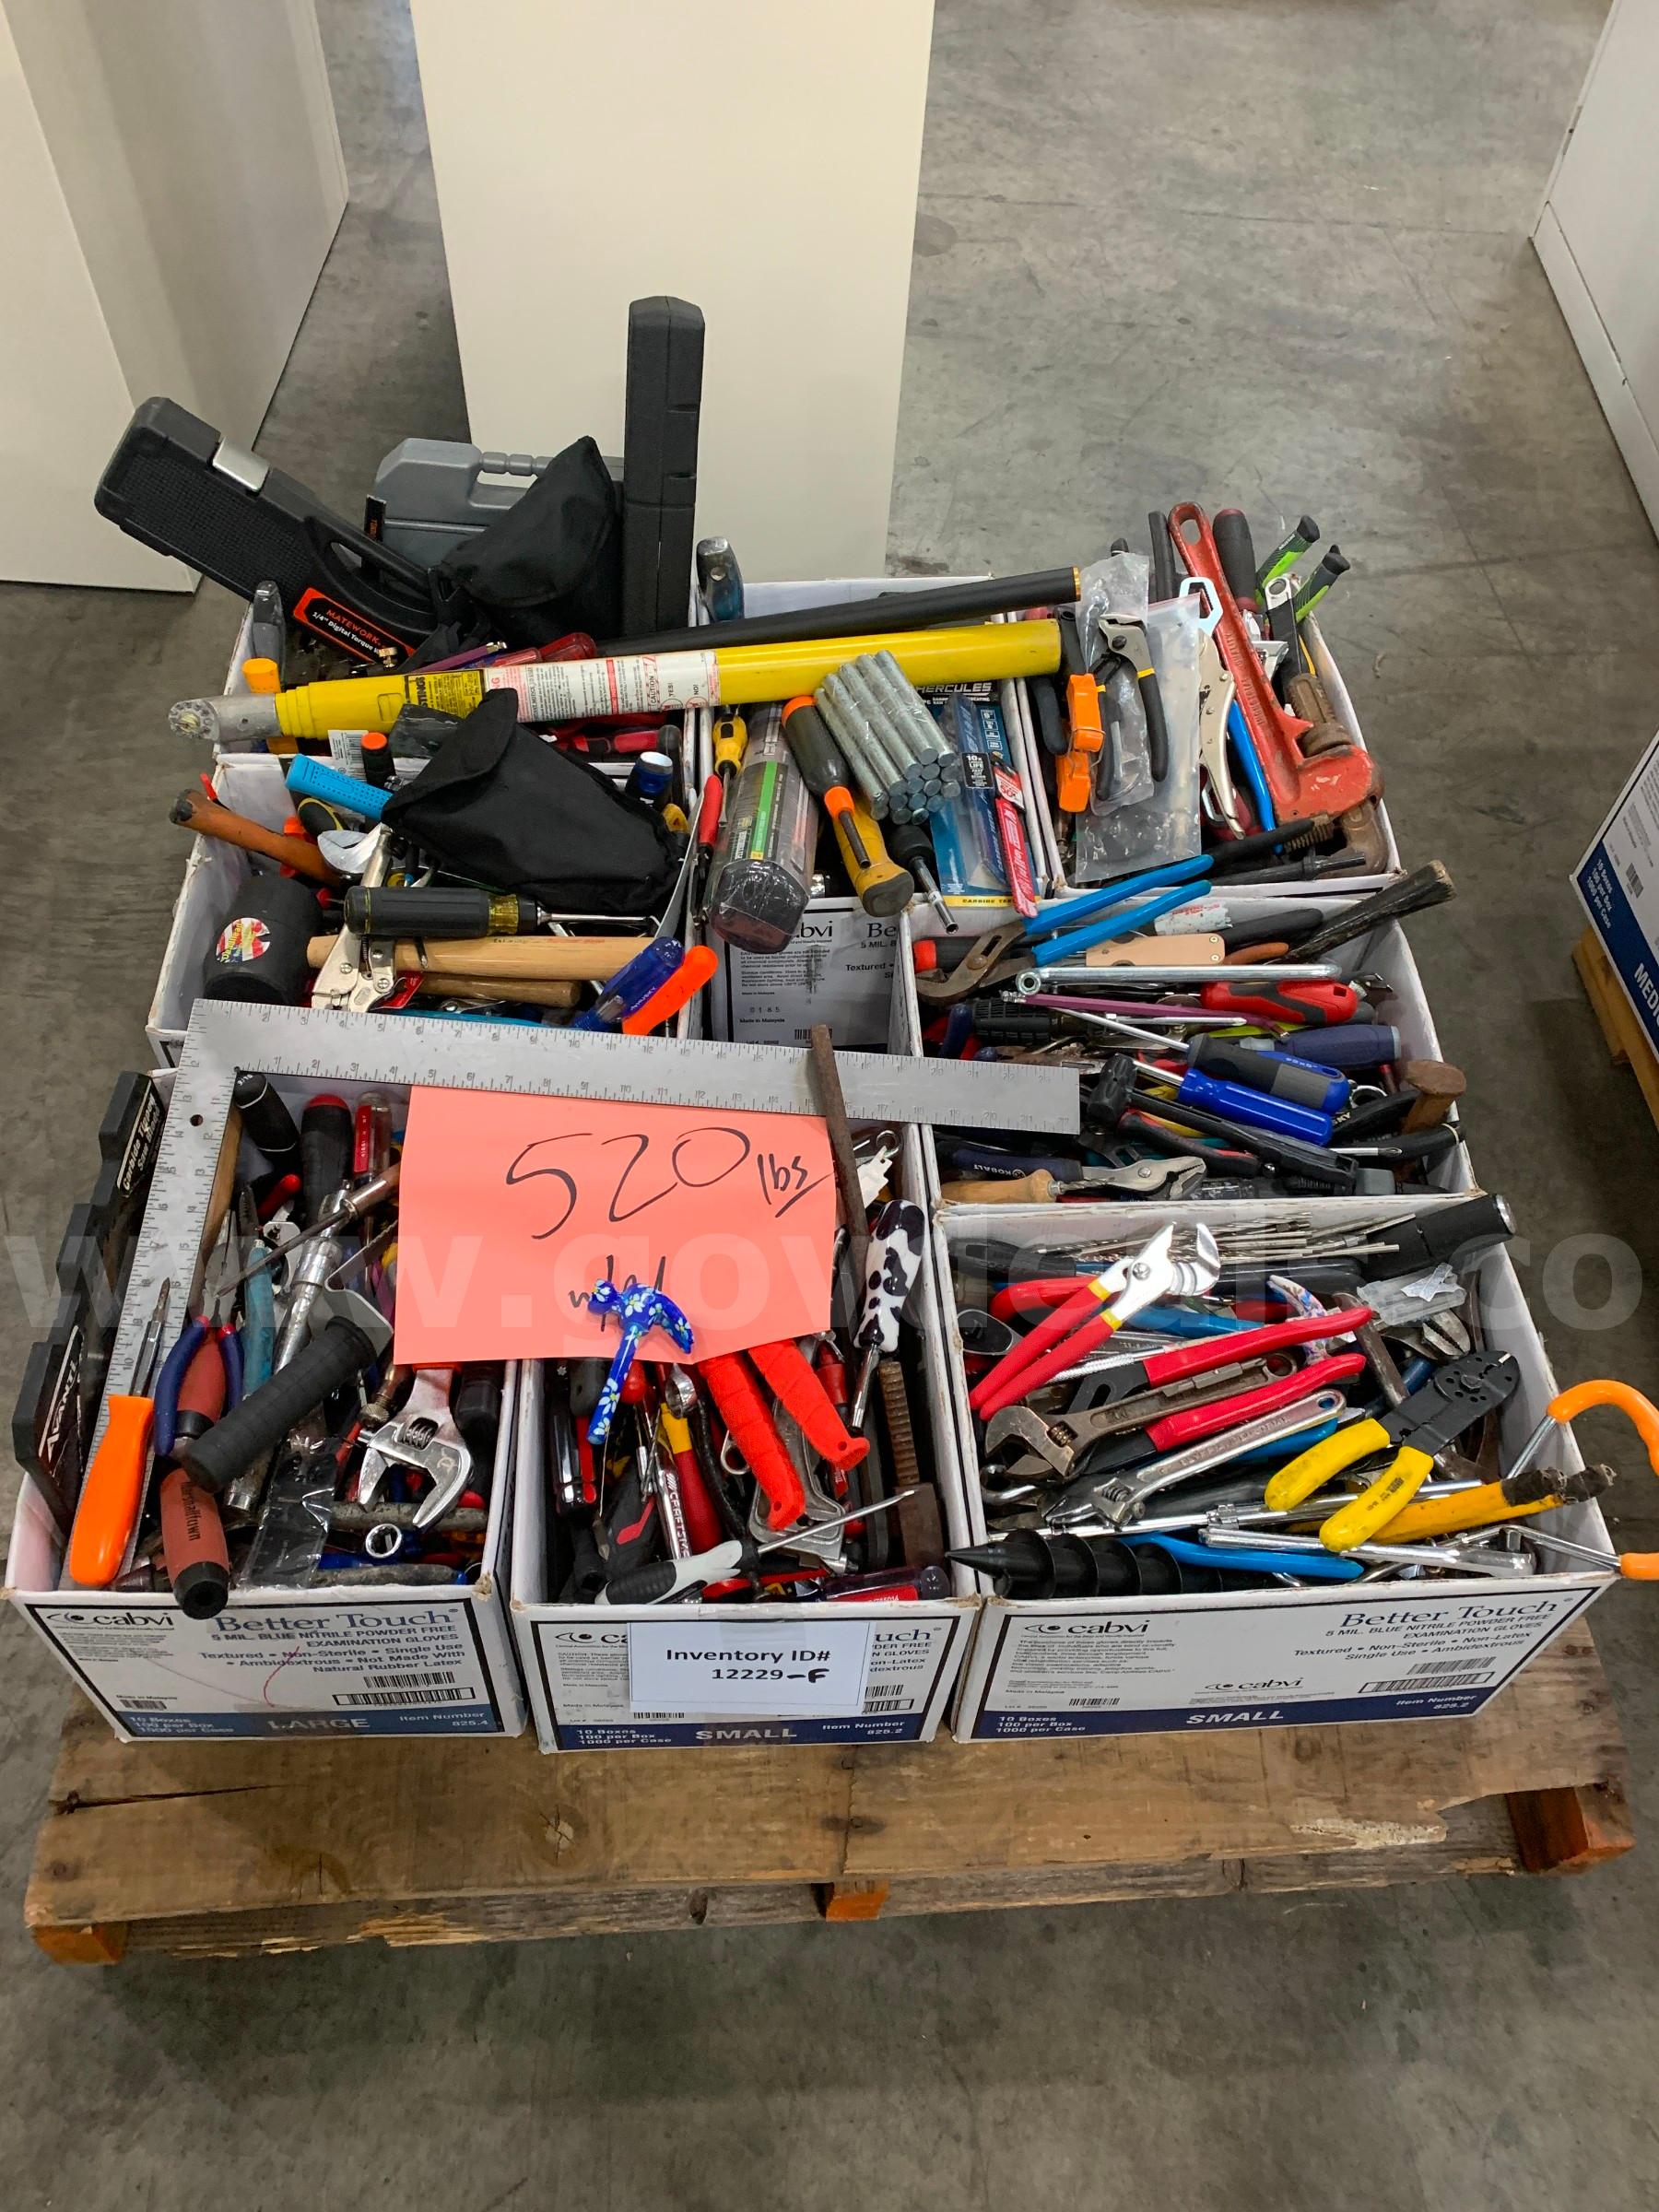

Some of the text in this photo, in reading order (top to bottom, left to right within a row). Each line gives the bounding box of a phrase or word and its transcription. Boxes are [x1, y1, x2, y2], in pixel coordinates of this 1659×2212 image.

[327, 620, 351, 638] Digital
[351, 634, 373, 651] Torque
[915, 683, 993, 693] HERCULES
[796, 921, 833, 938] bvi
[846, 963, 887, 971] Textured
[1634, 962, 1659, 1028] MEDI
[123, 1138, 141, 1191] Carbide
[138, 1146, 148, 1171] Saw
[973, 1164, 1012, 1176] KOBALT
[505, 1126, 836, 1239] 520 lbs
[669, 1493, 691, 1559] CRAFTSMA
[93, 1612, 174, 1626] cabvi
[211, 1610, 454, 1631] Better Touch
[1340, 1600, 1558, 1628] Better Touch
[1067, 1619, 1151, 1634] cabvi
[1369, 1626, 1403, 1634] BLUE
[1406, 1621, 1455, 1631] NITRILE
[1458, 1618, 1515, 1628] POWDER
[1517, 1614, 1550, 1622] FREE
[1403, 1622, 1543, 1639] EXAMINATION GLOVES
[257, 1632, 296, 1641] BLUE
[299, 1630, 352, 1640] NITRILE
[356, 1629, 416, 1637] POWDER
[421, 1626, 456, 1634] FREE
[307, 1634, 459, 1647] EXAMINATION GLOVES
[876, 1630, 931, 1642] uch
[1294, 1631, 1532, 1656] Textured Non-Sterile Non-Latex
[1345, 1652, 1387, 1661] Single
[1433, 1640, 1525, 1653] Ambidextrous
[240, 1658, 341, 1666] Ambidextrous
[389, 1653, 429, 1662] Made
[432, 1650, 465, 1658] With
[281, 1649, 366, 1658] Non-Sterile
[385, 1646, 431, 1654] Single
[666, 1649, 831, 1664] Inventory ID#
[885, 1649, 930, 1657] GLOVES
[424, 1659, 463, 1667] Latex
[1238, 1677, 1304, 1689] cabvi
[1395, 1694, 1477, 1706] Item Number
[268, 1718, 370, 1729] LARGE
[399, 1712, 486, 1722] Item Number
[1186, 1711, 1284, 1724] SMALL
[854, 1721, 906, 1729] Number
[695, 1729, 797, 1740] SMALL
